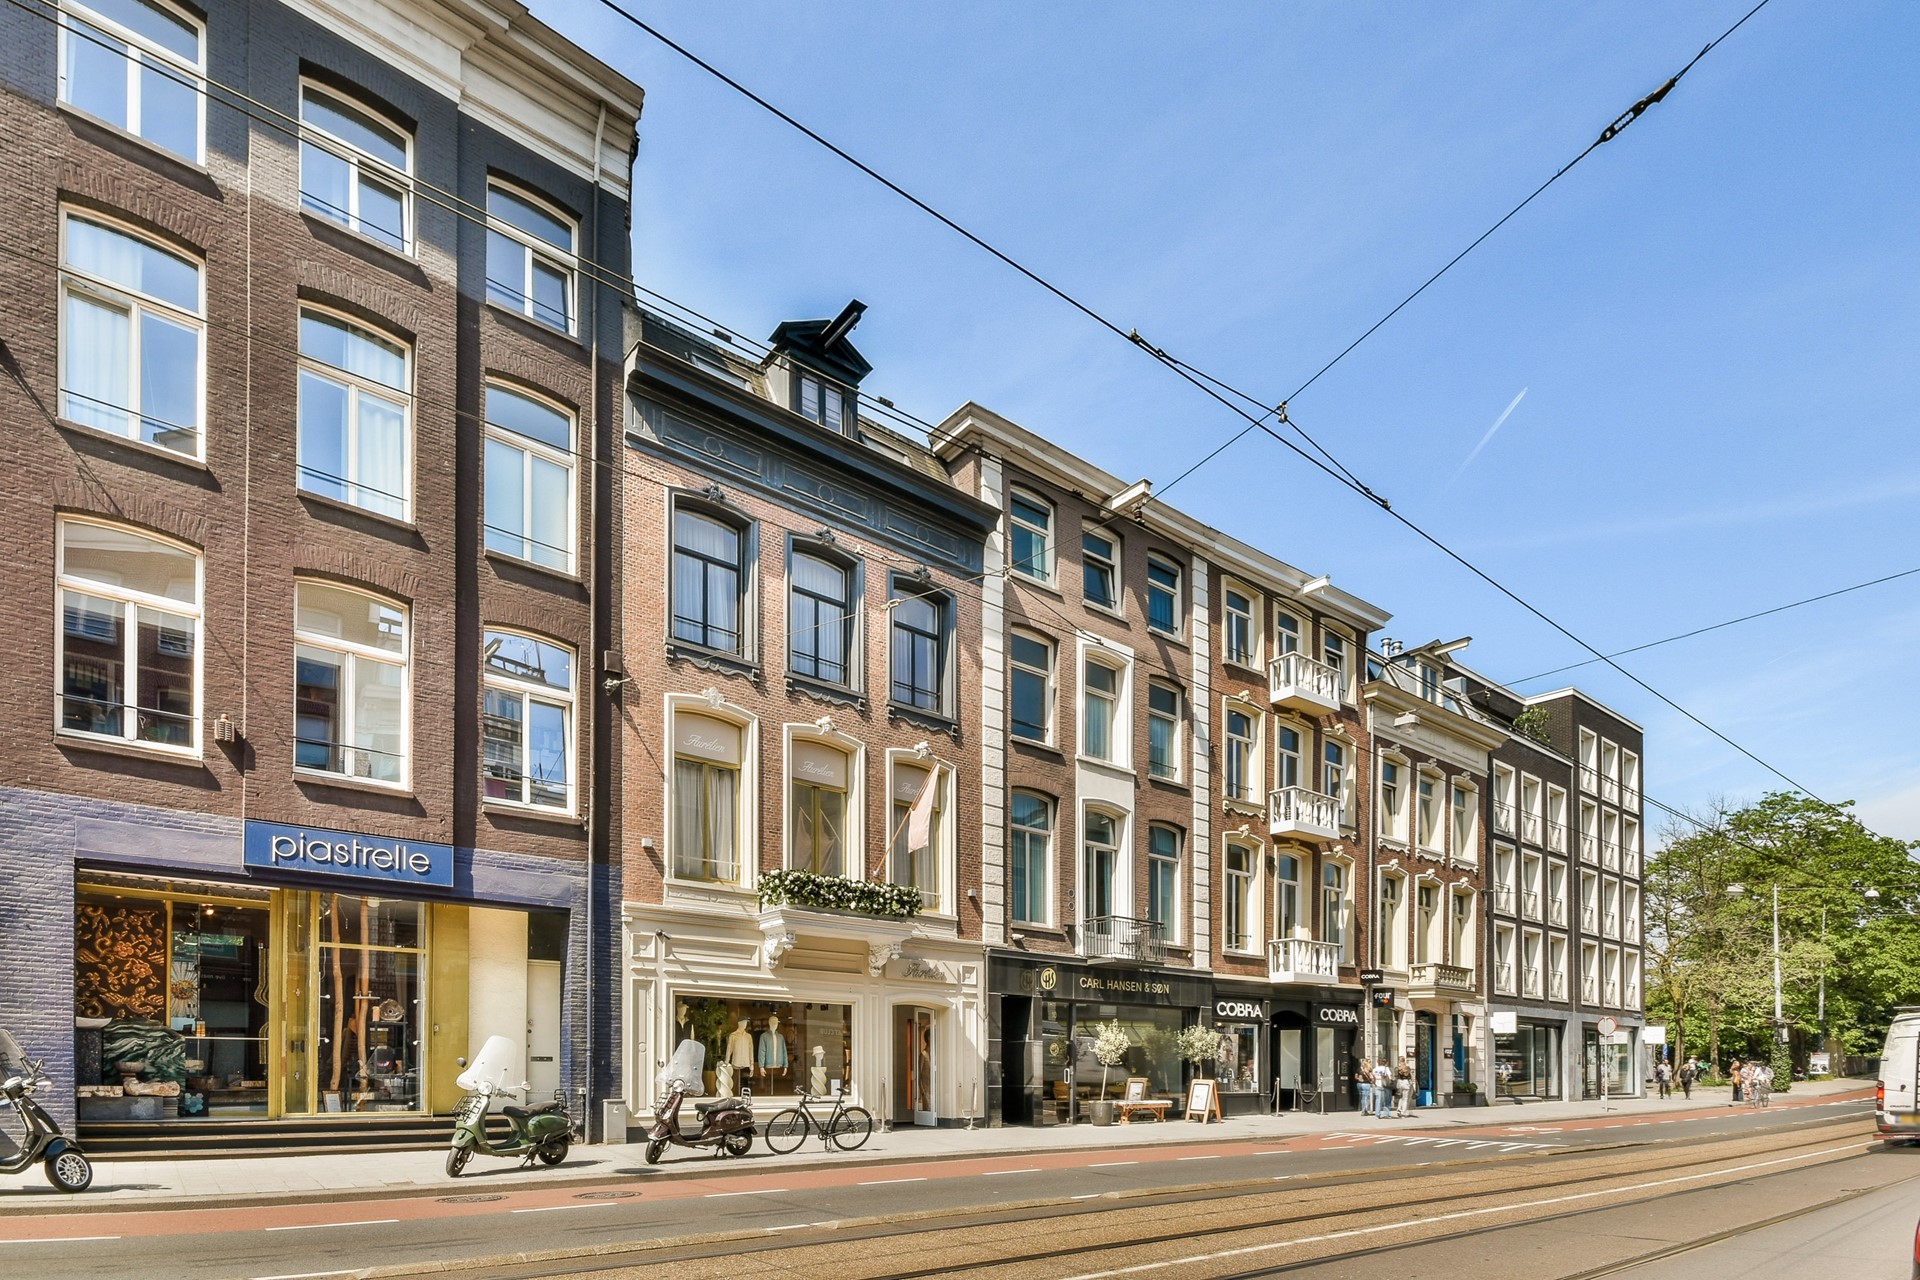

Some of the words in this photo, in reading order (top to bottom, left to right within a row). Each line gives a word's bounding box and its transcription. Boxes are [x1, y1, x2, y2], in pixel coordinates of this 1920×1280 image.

[272, 832, 430, 873] piastrelle
[1079, 977, 1104, 989] CARL
[1106, 980, 1142, 992] HANSEN
[1144, 982, 1150, 993] &
[1151, 983, 1170, 994] SØN
[1216, 1001, 1263, 1018] COBRA
[1320, 1008, 1359, 1023] COBRA
